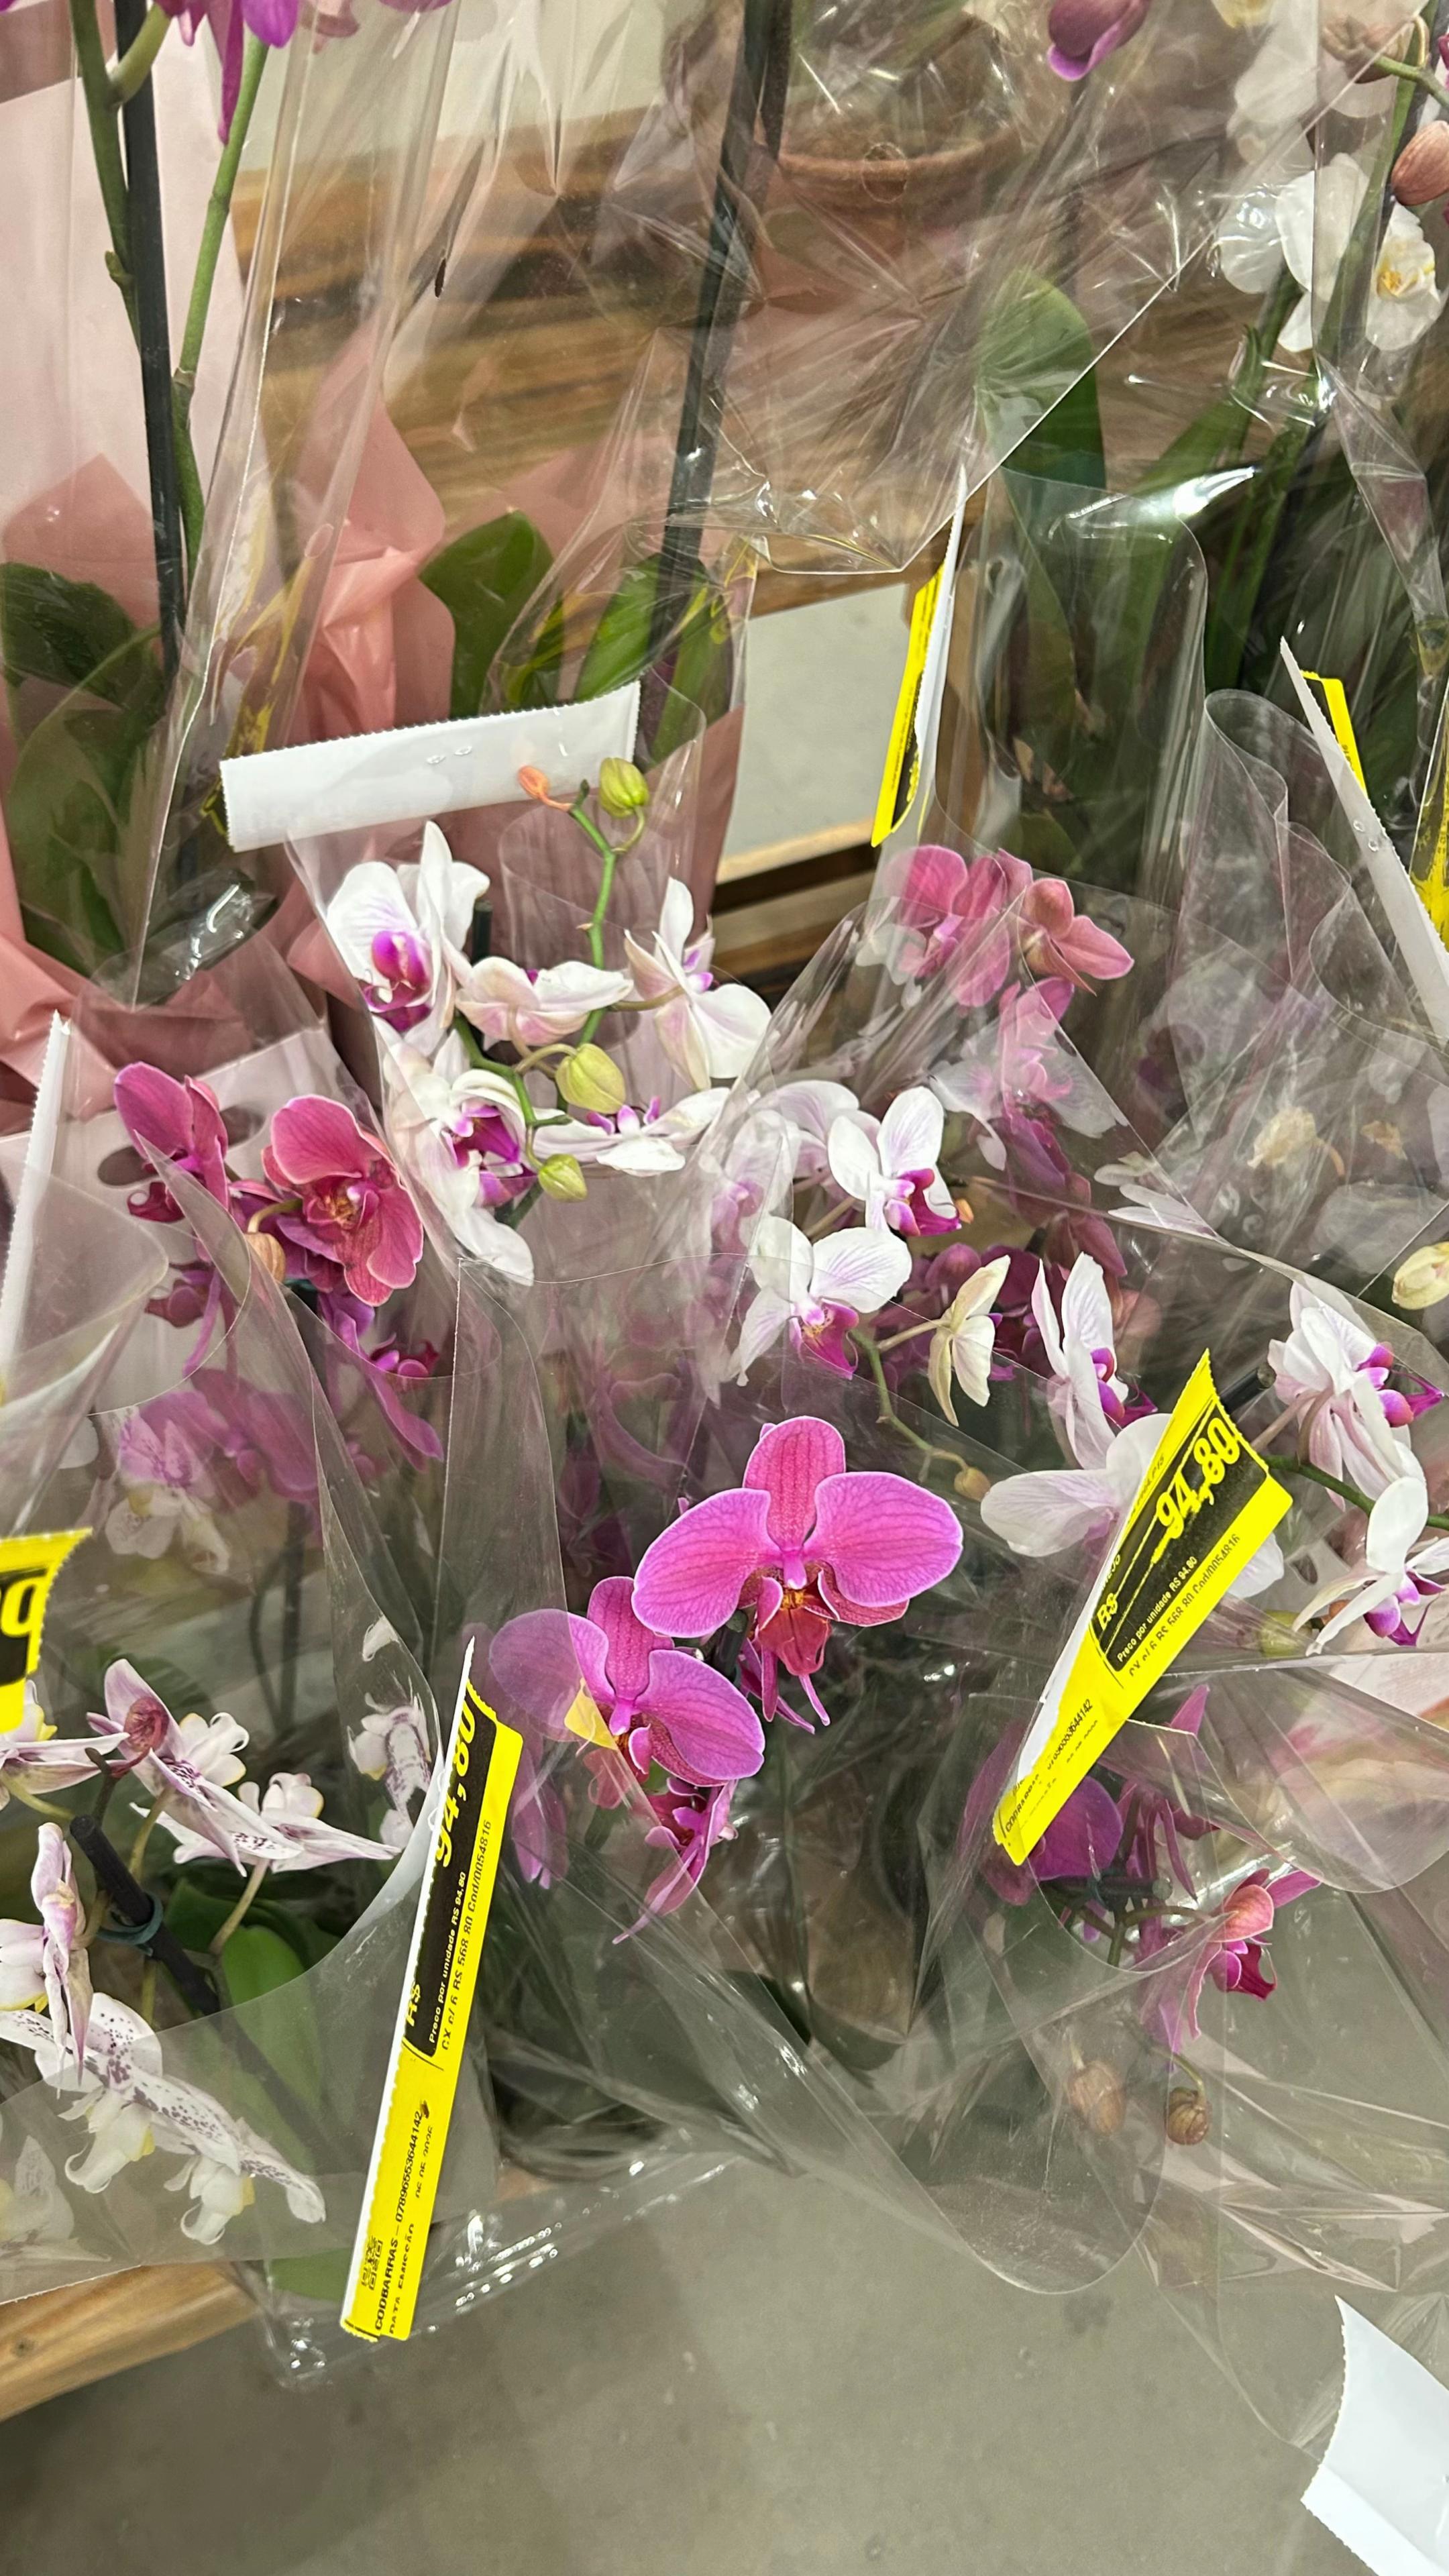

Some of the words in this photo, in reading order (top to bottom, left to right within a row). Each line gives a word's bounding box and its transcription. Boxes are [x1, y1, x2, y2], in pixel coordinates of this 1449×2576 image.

[1156, 1417, 1240, 1538] 94,80
[1134, 1621, 1148, 1640] por
[1146, 1590, 1171, 1623] unidade
[454, 1870, 466, 1905] 94,80
[441, 2027, 451, 2050] CX
[450, 1994, 458, 2005] 6
[467, 1819, 492, 1912] Cod/0054816
[441, 1928, 456, 1978] unidade
[437, 1981, 446, 2003] por
[374, 2237, 398, 2330] CODBARRAS
[396, 2111, 422, 2222] 07896553644142
